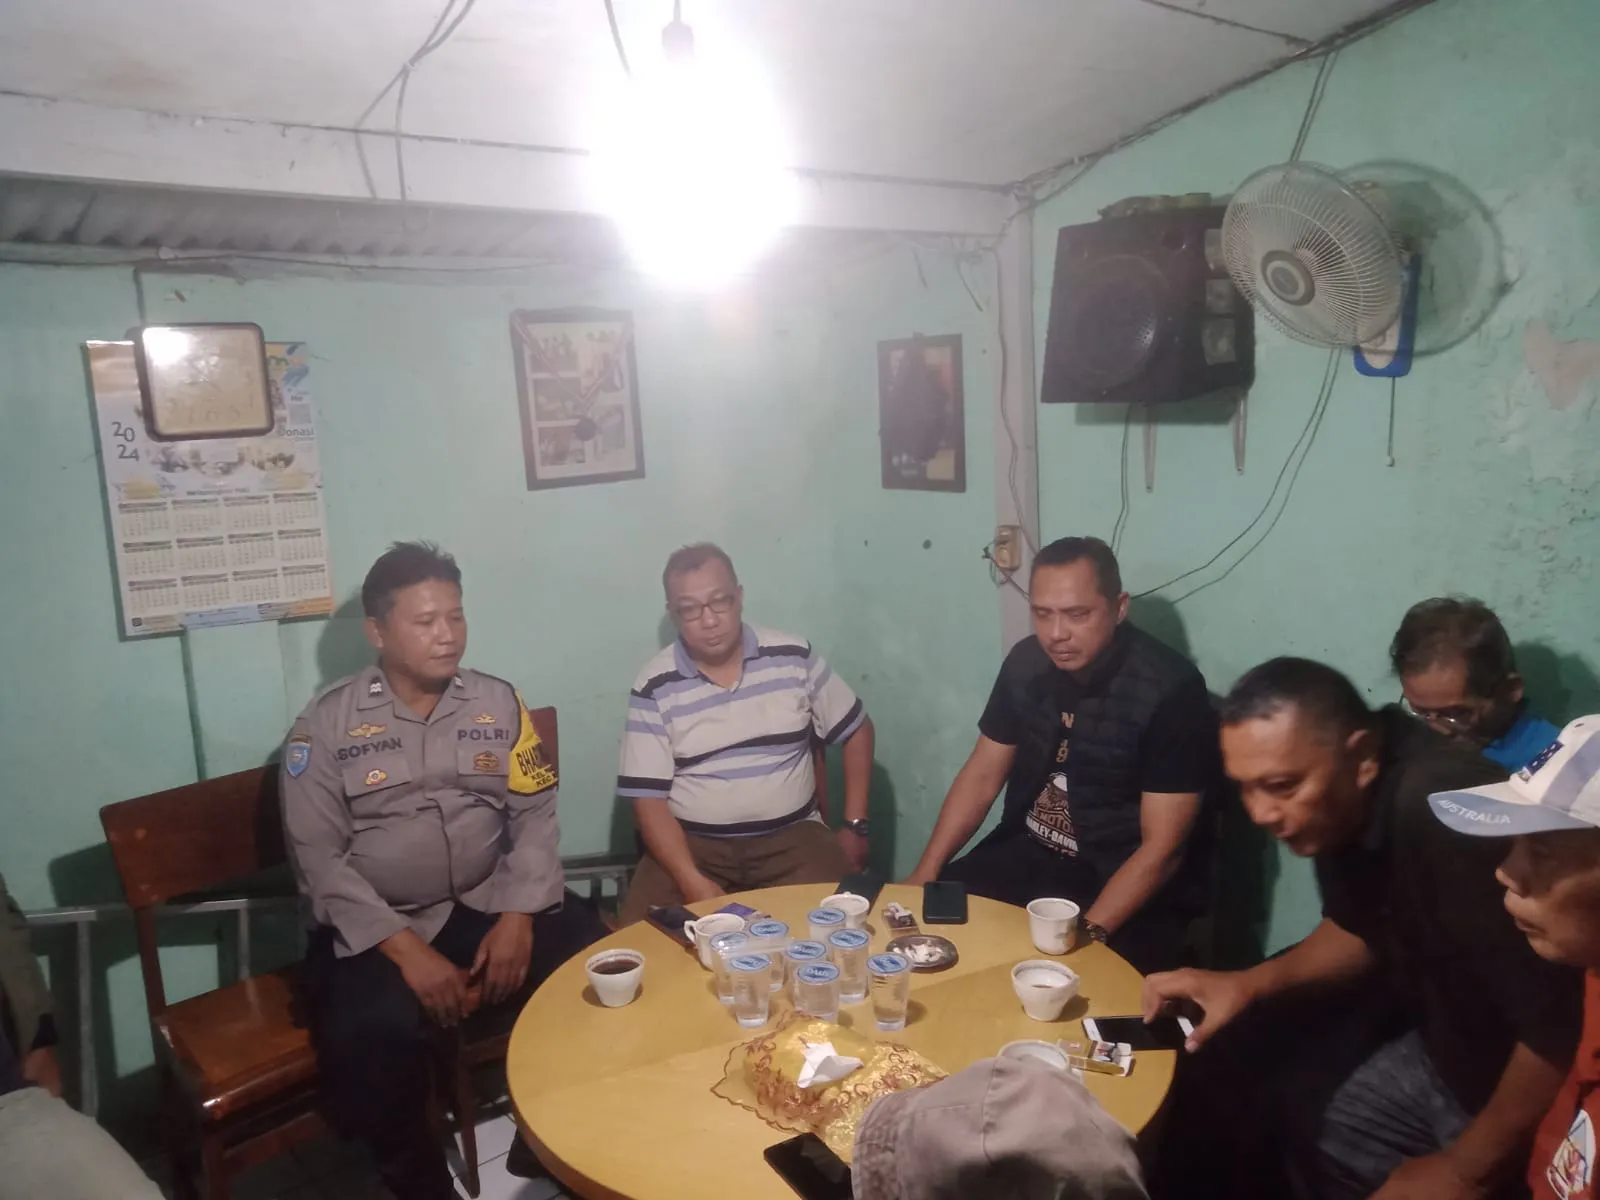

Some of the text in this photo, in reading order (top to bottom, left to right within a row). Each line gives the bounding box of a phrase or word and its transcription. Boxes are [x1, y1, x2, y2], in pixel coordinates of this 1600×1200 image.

[111, 421, 136, 443] 20
[117, 444, 140, 462] 24
[457, 729, 510, 742] POLRI
[337, 737, 403, 761] SOFYAN
[1436, 800, 1512, 824] AUSTRALIA
